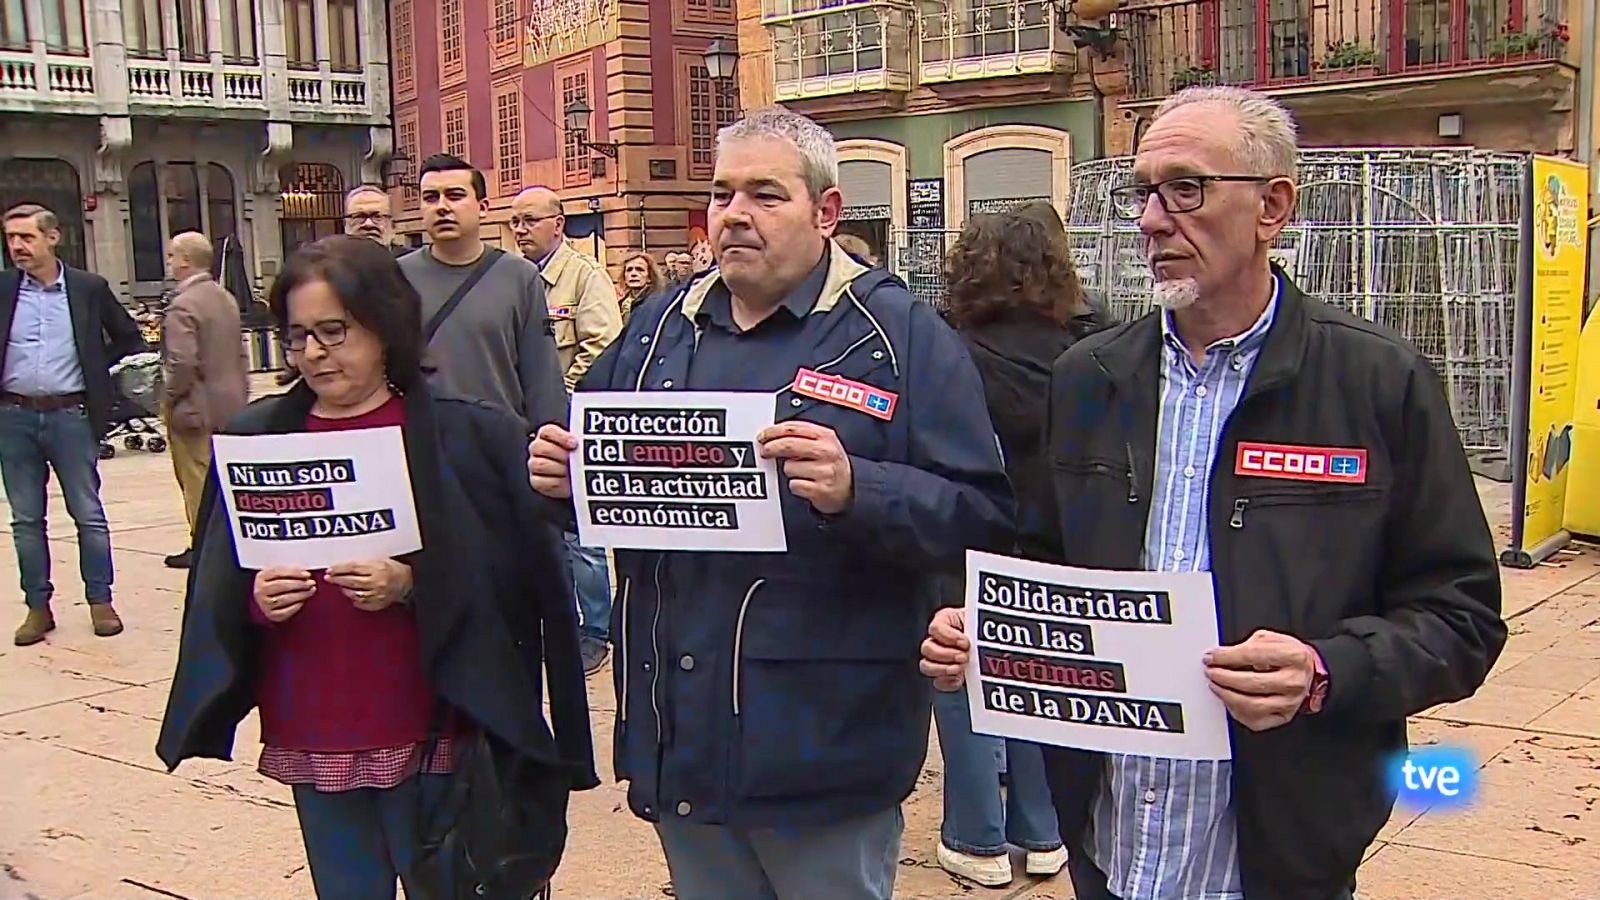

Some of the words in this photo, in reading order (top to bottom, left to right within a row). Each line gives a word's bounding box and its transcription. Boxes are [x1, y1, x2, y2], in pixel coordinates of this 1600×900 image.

[799, 375, 864, 405] CCOO
[587, 411, 720, 435] Protección
[588, 439, 627, 462] del
[632, 442, 725, 468] empleo
[730, 447, 747, 468] y
[1242, 449, 1325, 475] CCOO
[232, 465, 257, 485] Ni
[260, 469, 293, 485] un
[297, 462, 348, 483] solo
[591, 473, 619, 495] de
[622, 473, 646, 495] la
[650, 472, 765, 497] actividad
[239, 491, 326, 516] despido
[595, 504, 731, 528] económica
[244, 521, 280, 540] por
[283, 519, 309, 537] la
[311, 512, 389, 535] DANA
[983, 577, 1162, 622] Solidaridad
[982, 620, 1033, 647] con
[1037, 623, 1085, 653] las
[984, 653, 1116, 690] víctimas
[990, 687, 1025, 712] de
[1030, 691, 1062, 720] la
[1067, 697, 1170, 730] DANA
